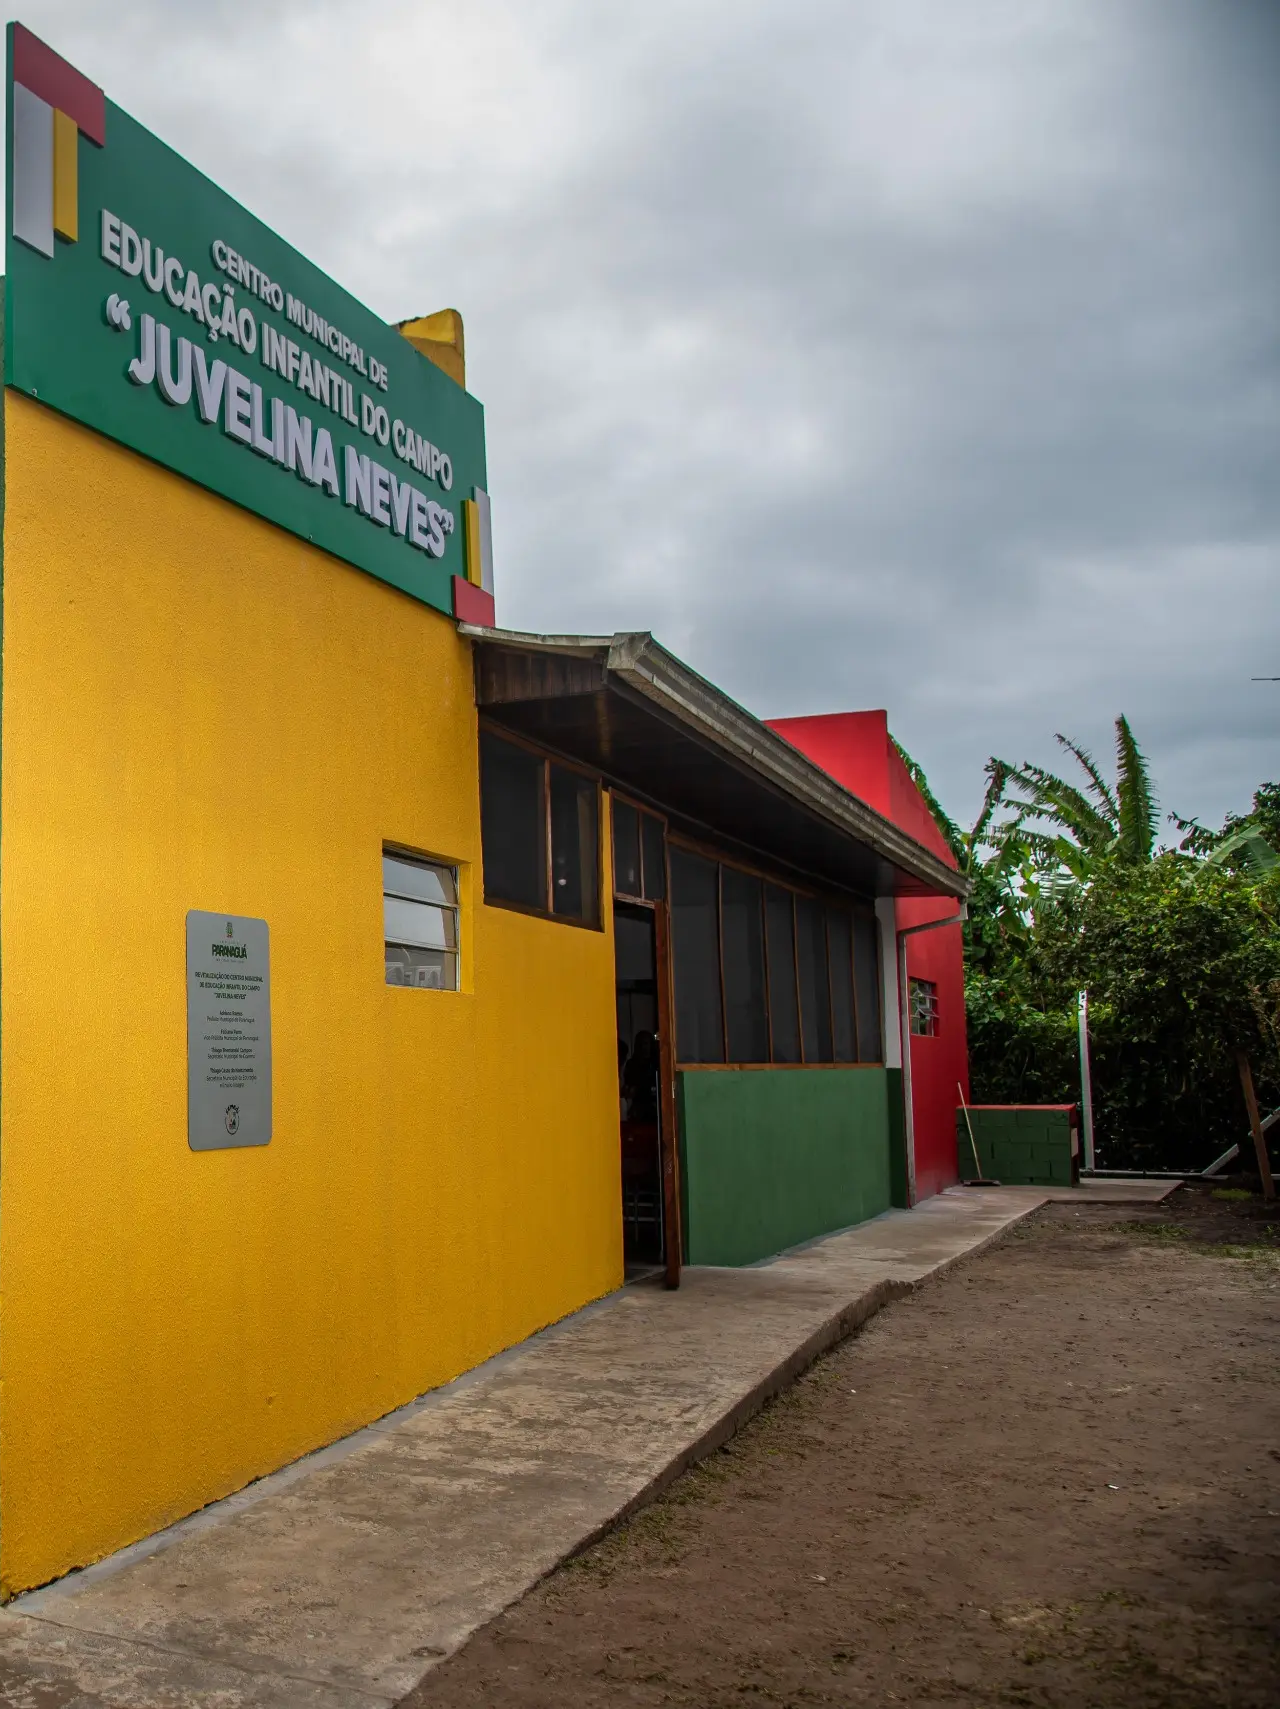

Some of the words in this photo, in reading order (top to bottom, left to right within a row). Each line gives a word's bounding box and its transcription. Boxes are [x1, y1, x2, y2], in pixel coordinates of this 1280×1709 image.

[211, 240, 284, 312] CENTRO
[286, 292, 367, 375] MUNICIPAL
[368, 355, 388, 391] DE
[101, 208, 257, 356] EDUCAÇÃO
[261, 322, 359, 427] INFANTIL
[361, 391, 390, 446] DO
[391, 418, 453, 490] CAMPO
[211, 943, 248, 960] PARANAGUÁ
[205, 981, 226, 990] EDUCAÇÃO
[245, 975, 264, 983] MUNICIPAL
